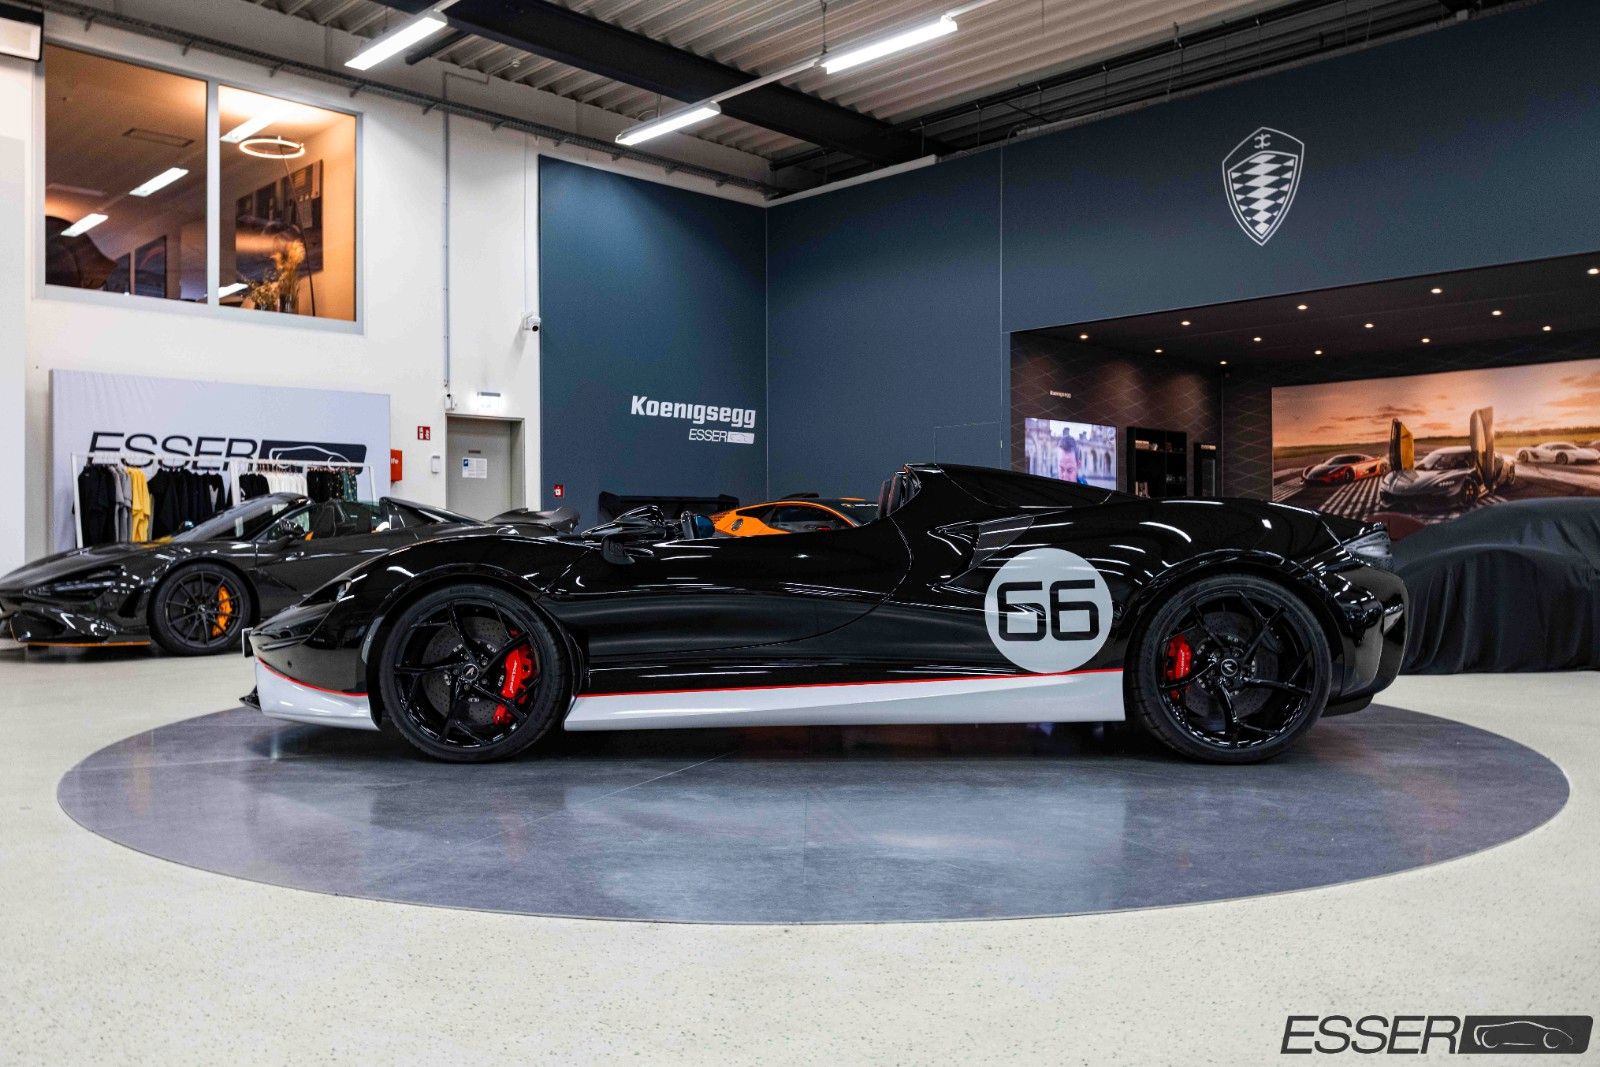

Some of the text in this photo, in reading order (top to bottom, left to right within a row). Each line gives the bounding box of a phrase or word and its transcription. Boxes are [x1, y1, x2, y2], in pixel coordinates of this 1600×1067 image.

[630, 395, 756, 429] Koenigsegg
[86, 431, 257, 472] ESSER
[688, 428, 728, 442] ESSER
[997, 579, 1100, 641] 66
